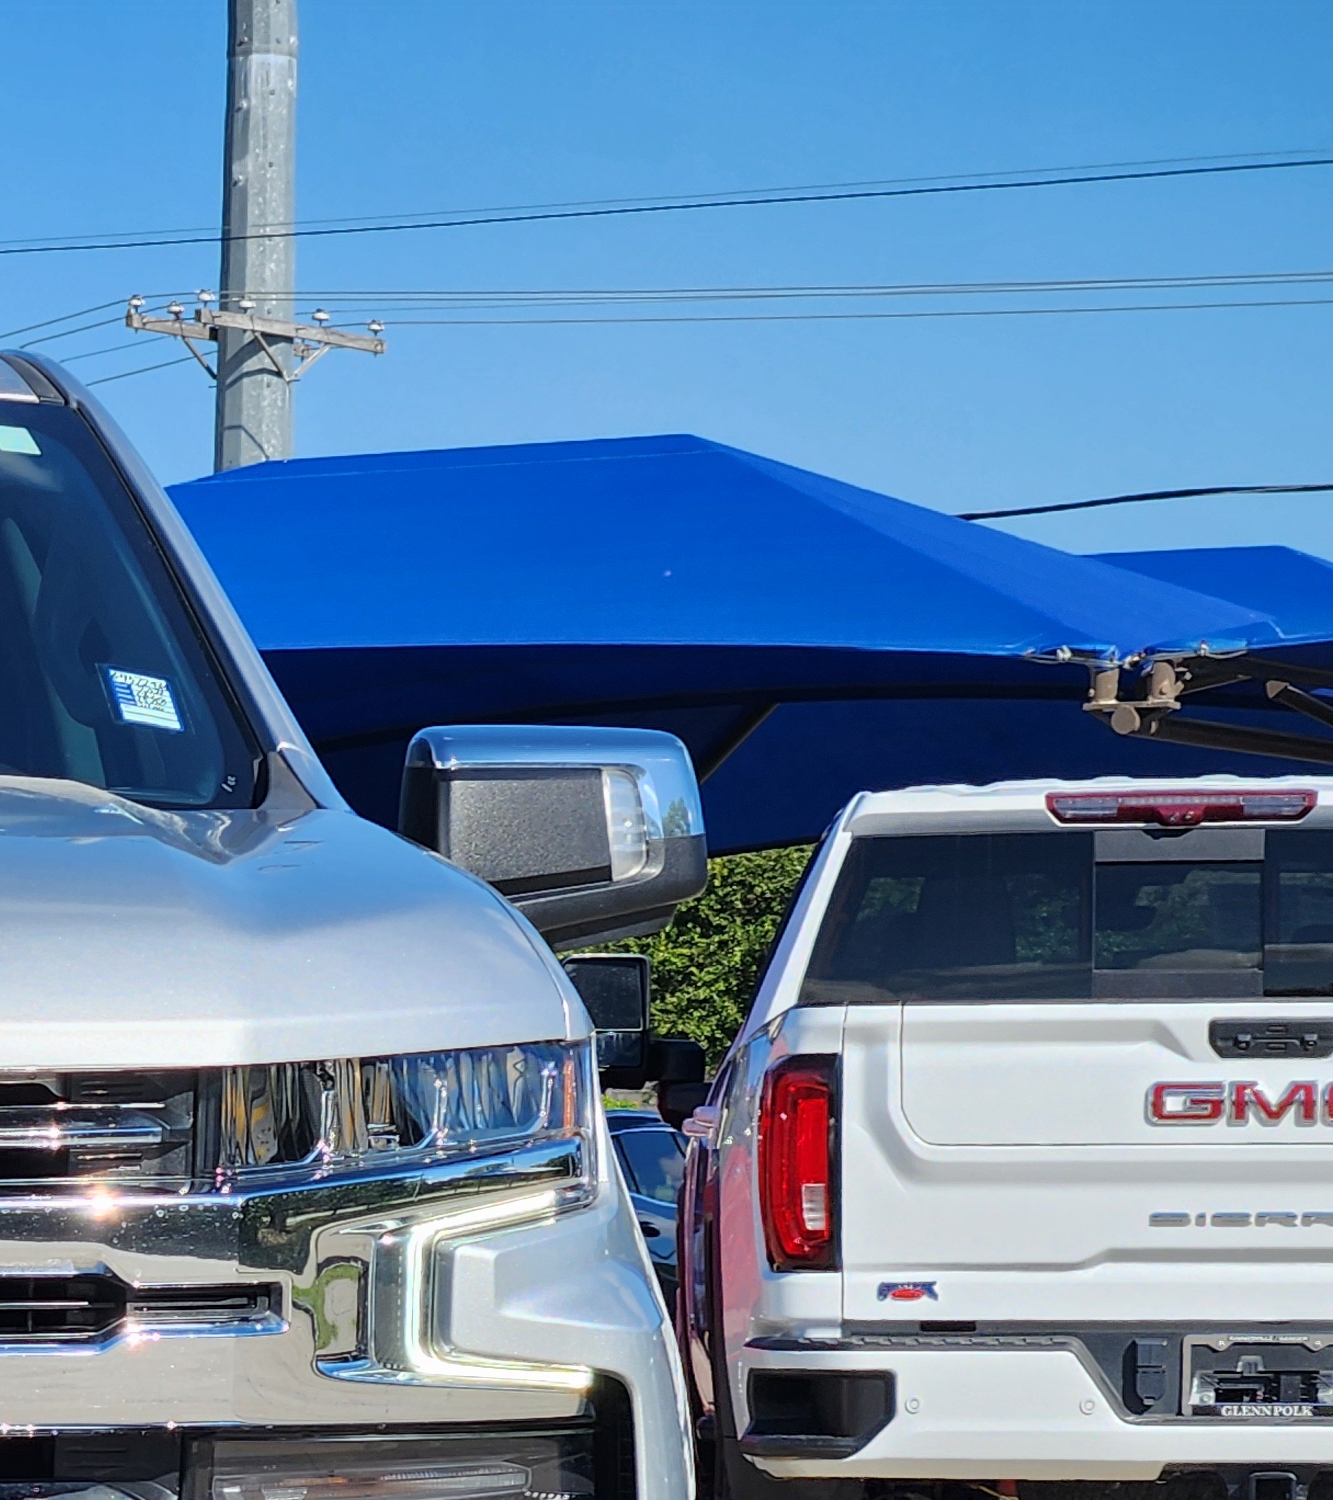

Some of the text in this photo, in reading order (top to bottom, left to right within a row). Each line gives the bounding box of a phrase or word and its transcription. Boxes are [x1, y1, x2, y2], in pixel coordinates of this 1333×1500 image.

[1144, 1081, 1333, 1128] GM
[1220, 1405, 1313, 1417] GLENN POLK
